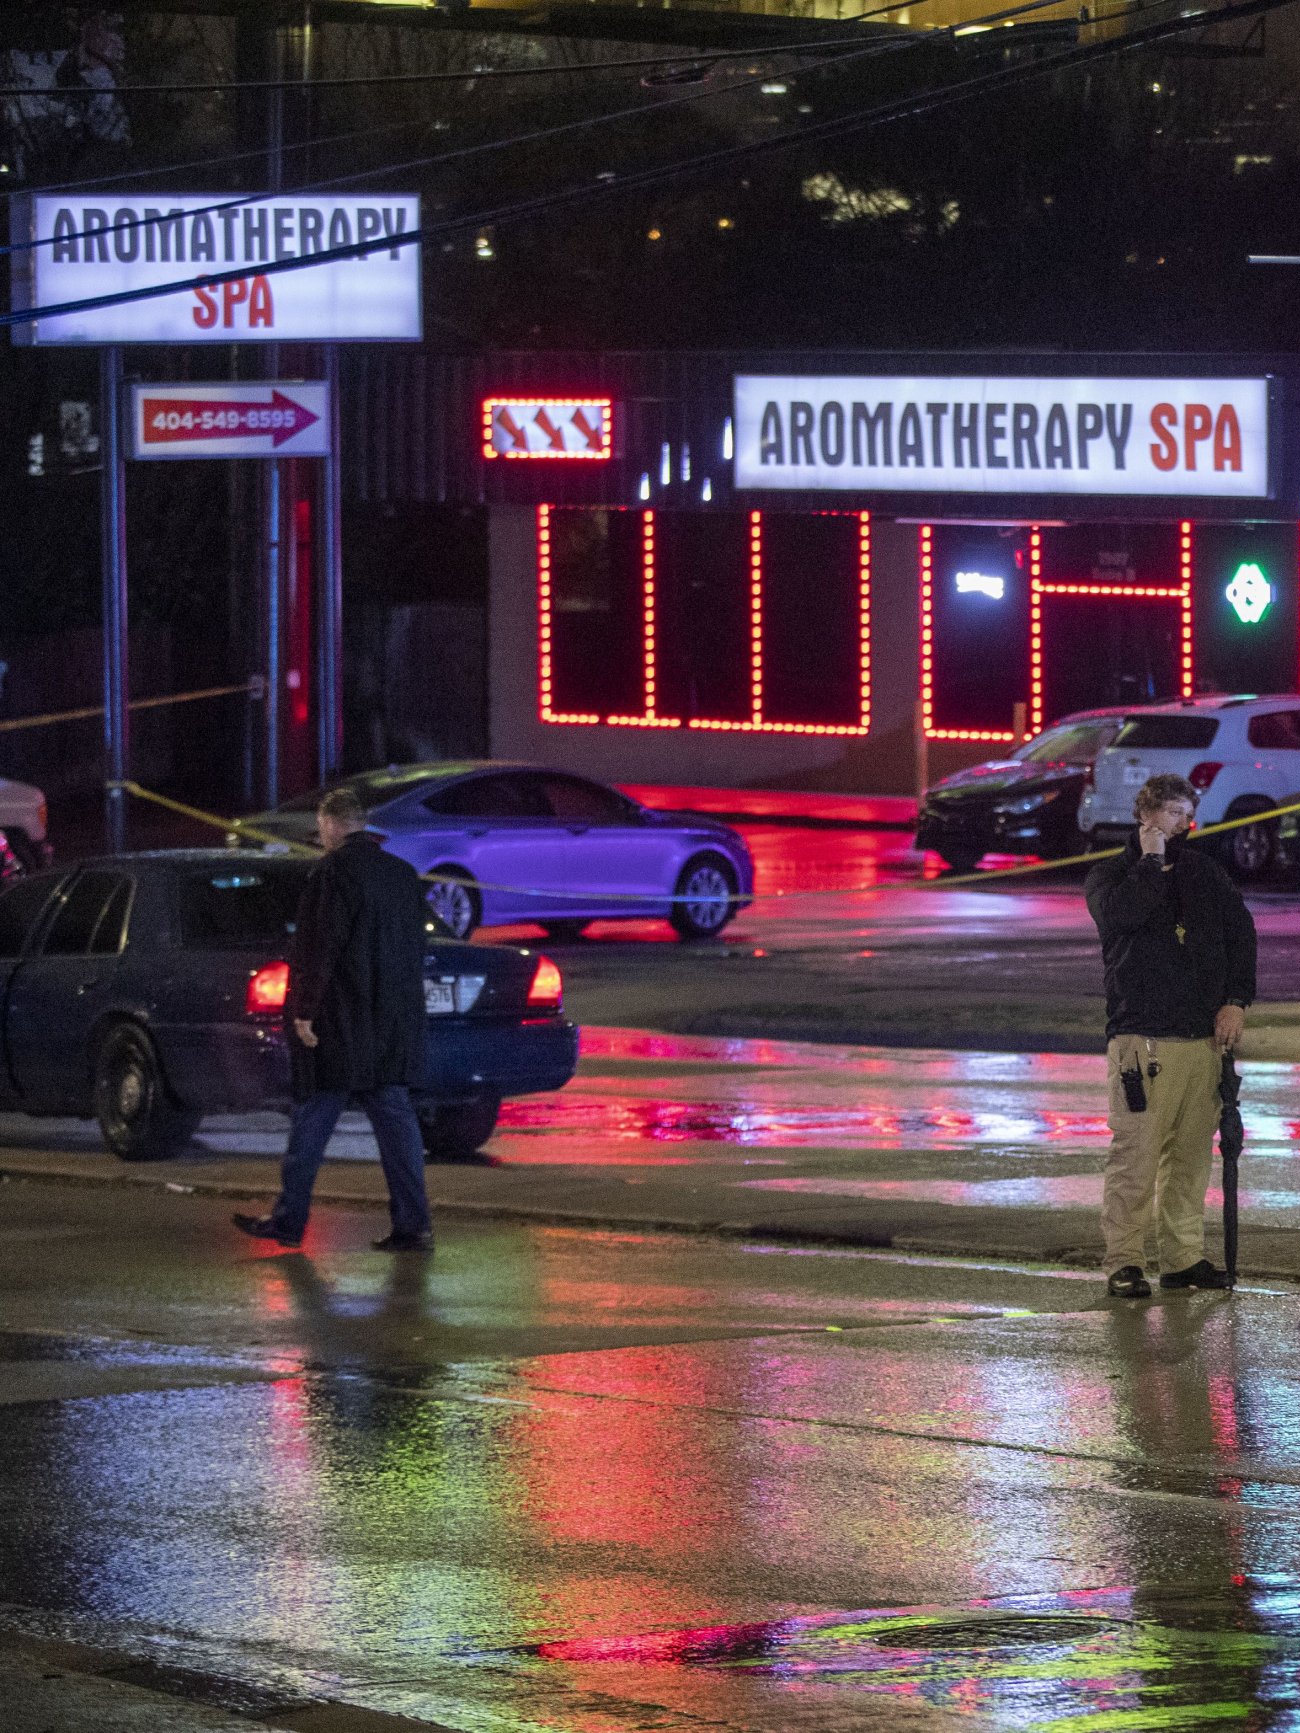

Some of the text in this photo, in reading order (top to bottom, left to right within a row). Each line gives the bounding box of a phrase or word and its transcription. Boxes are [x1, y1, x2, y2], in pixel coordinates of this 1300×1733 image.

[52, 207, 408, 264] AROMATHERAPY
[192, 273, 275, 329] SPA
[760, 400, 1243, 472] AROMATHERAPY SPA
